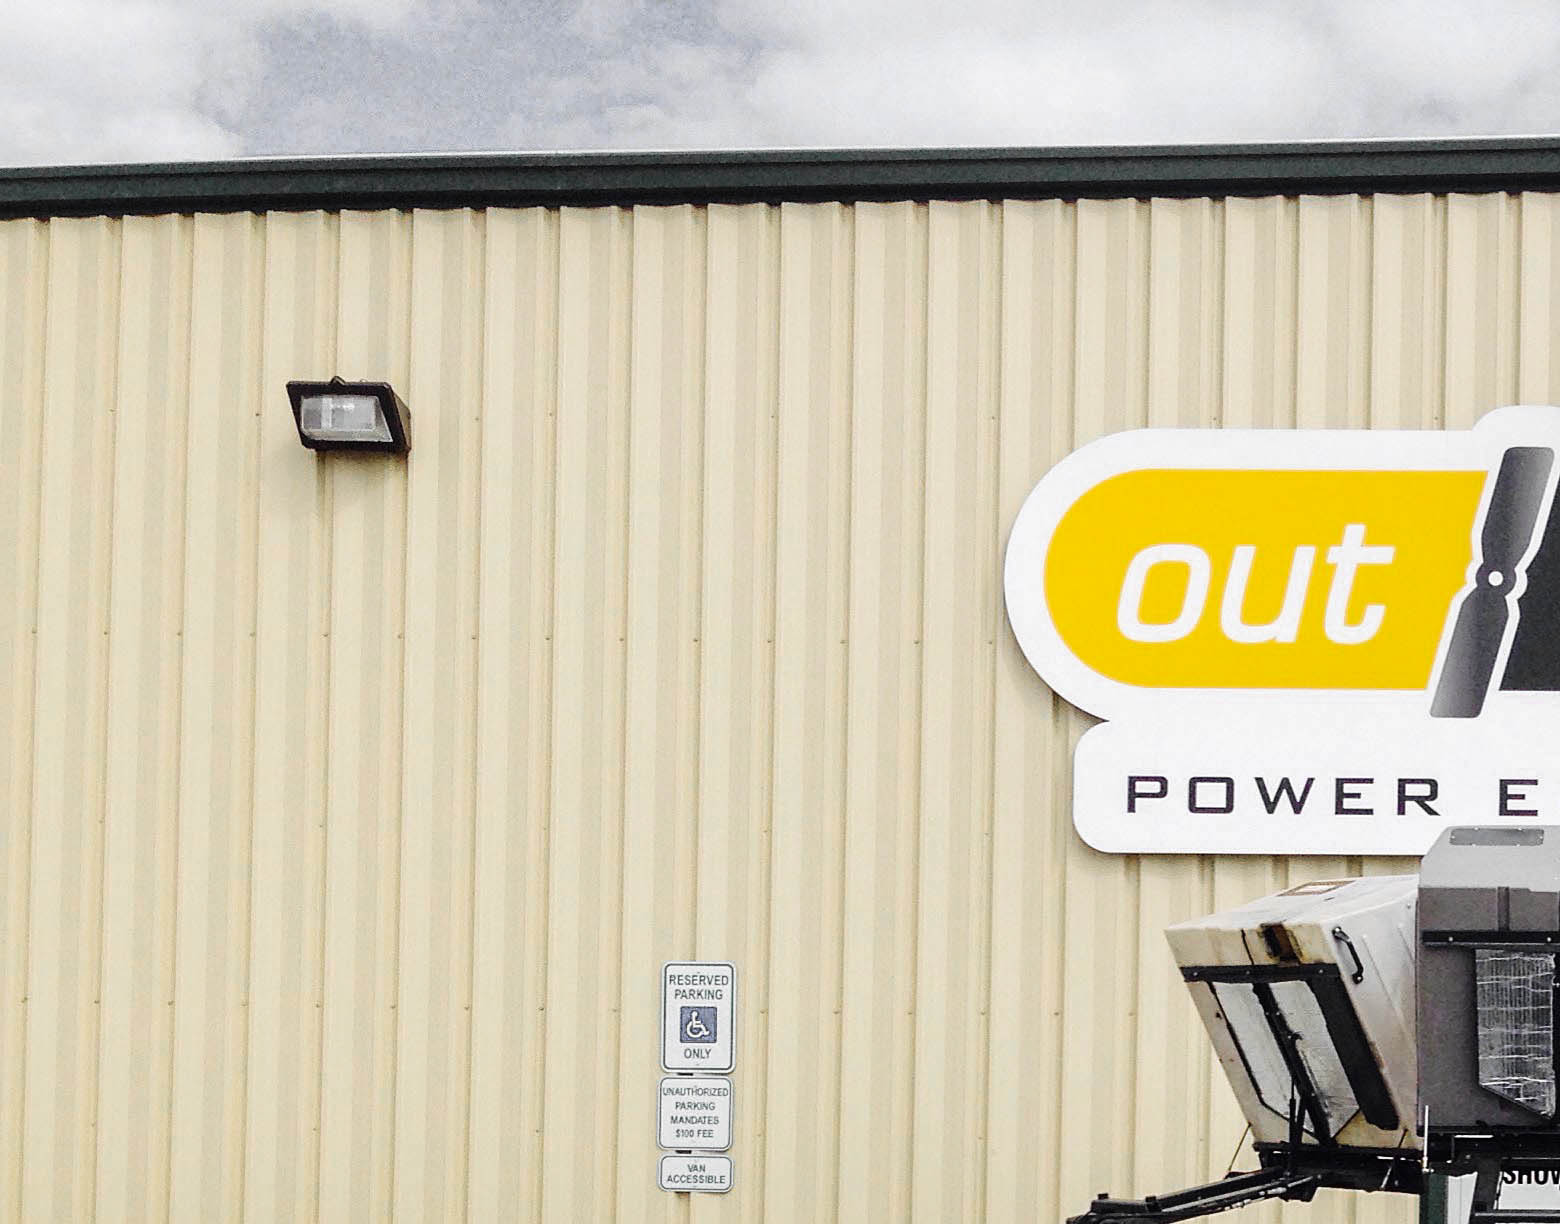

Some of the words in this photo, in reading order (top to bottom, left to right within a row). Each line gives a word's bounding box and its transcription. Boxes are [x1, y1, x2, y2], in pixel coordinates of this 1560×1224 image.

[1116, 523, 1397, 645] out
[1126, 775, 1442, 816] POWER
[668, 974, 729, 986] RESERVED
[674, 988, 724, 1000] PARKING
[683, 1048, 712, 1060] ONLY
[662, 1087, 729, 1097] UNAUTHORIZED
[674, 1101, 716, 1111] PARKING
[670, 1115, 720, 1125] MANDATES
[675, 1129, 695, 1138] $100
[697, 1129, 714, 1138] FEE
[687, 1164, 706, 1173] VAN
[666, 1174, 726, 1184] ACCESSIBLE
